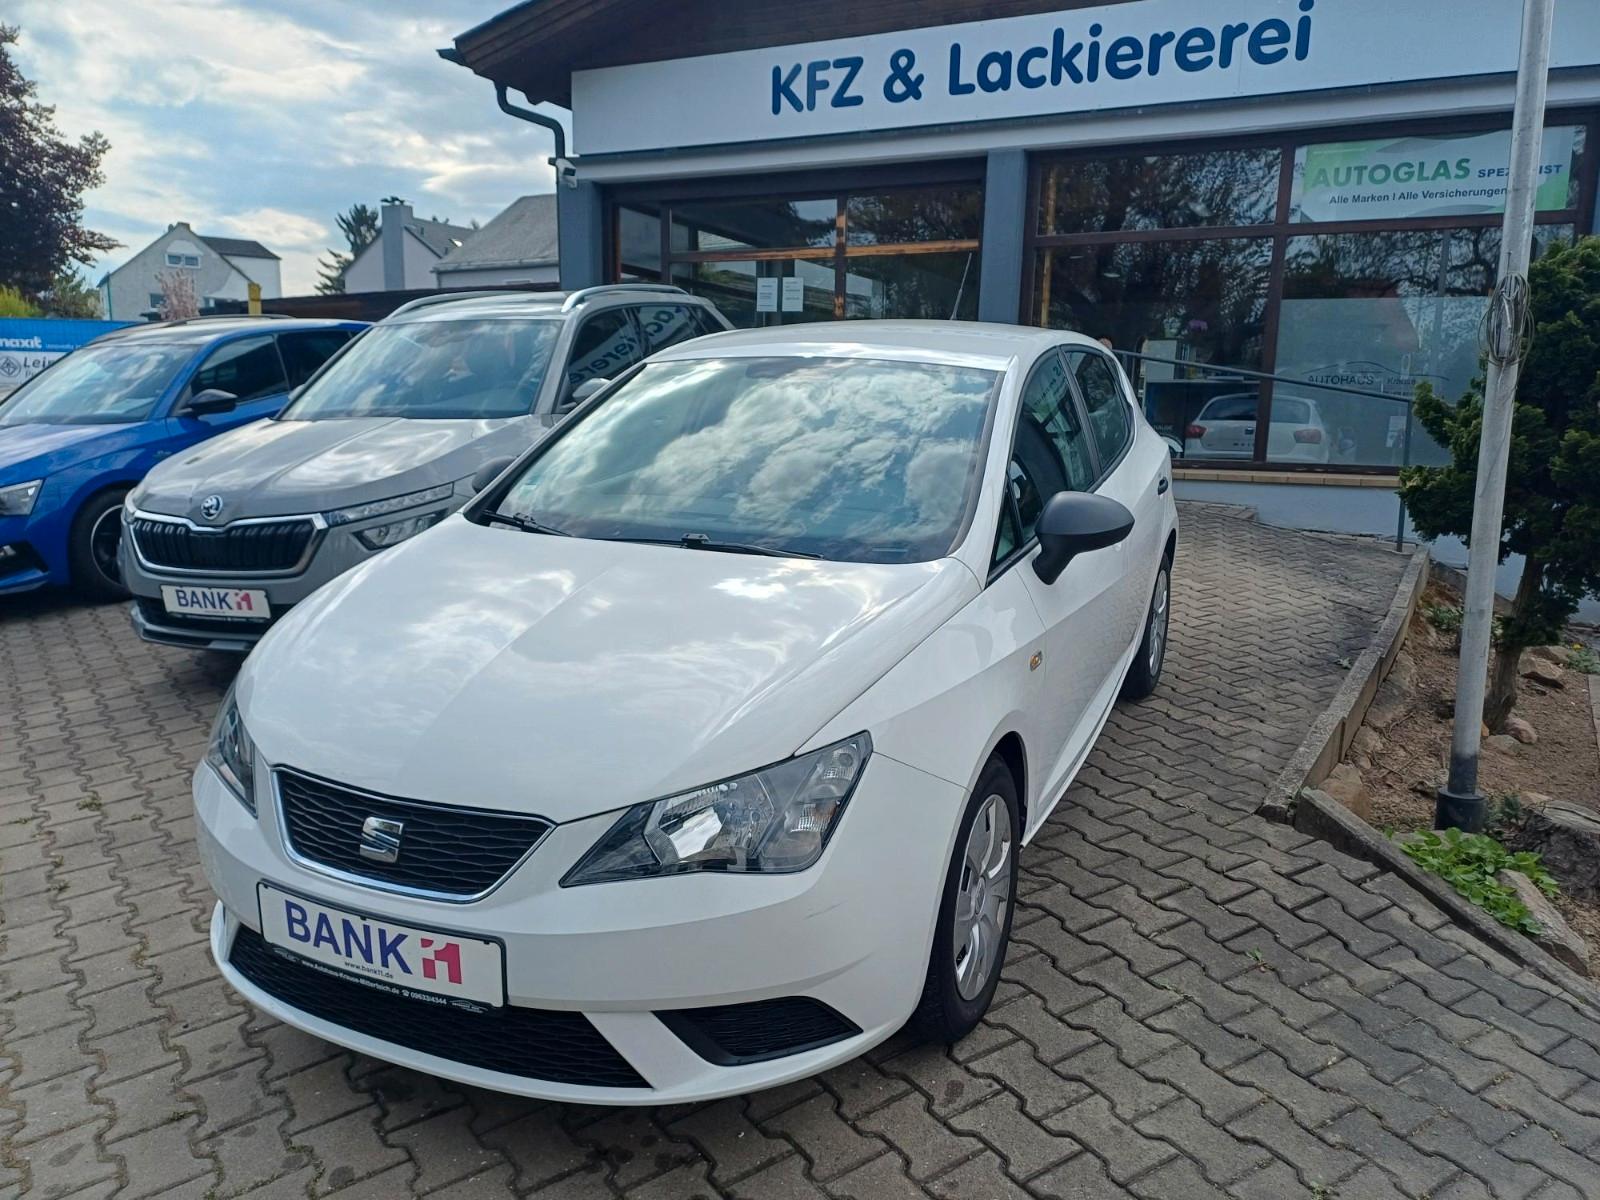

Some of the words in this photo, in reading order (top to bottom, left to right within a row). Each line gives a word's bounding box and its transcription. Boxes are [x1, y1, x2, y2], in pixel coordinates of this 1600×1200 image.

[772, 56, 864, 115] KFZ
[883, 48, 924, 103] &
[949, 0, 1314, 95] Lackiererei
[1311, 158, 1471, 188] AUTOGLAS
[1329, 195, 1349, 205] Alle
[1351, 193, 1390, 204] Marken
[1398, 191, 1419, 201] Alle
[1422, 188, 1508, 199] Versicherungen
